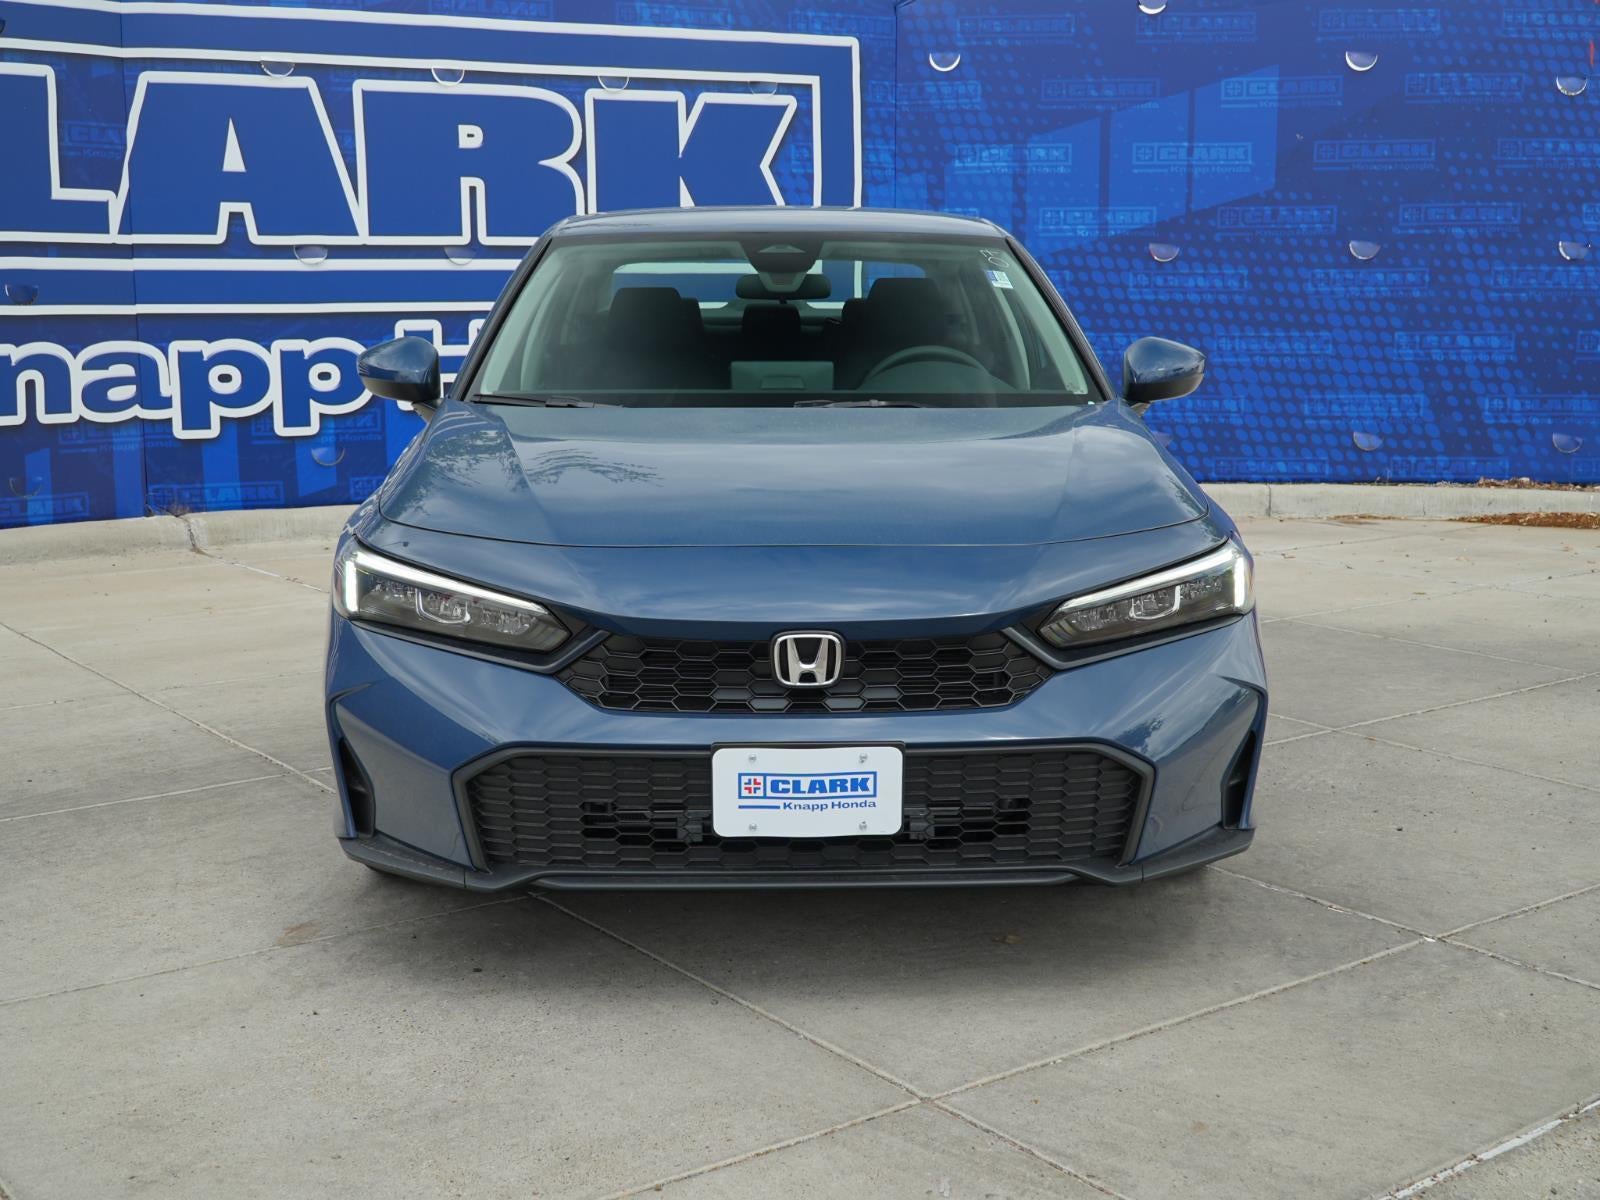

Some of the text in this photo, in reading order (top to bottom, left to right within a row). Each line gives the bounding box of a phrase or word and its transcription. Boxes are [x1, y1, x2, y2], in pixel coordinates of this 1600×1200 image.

[770, 777, 870, 794] CLARK
[783, 800, 877, 811] Knapp Honda
